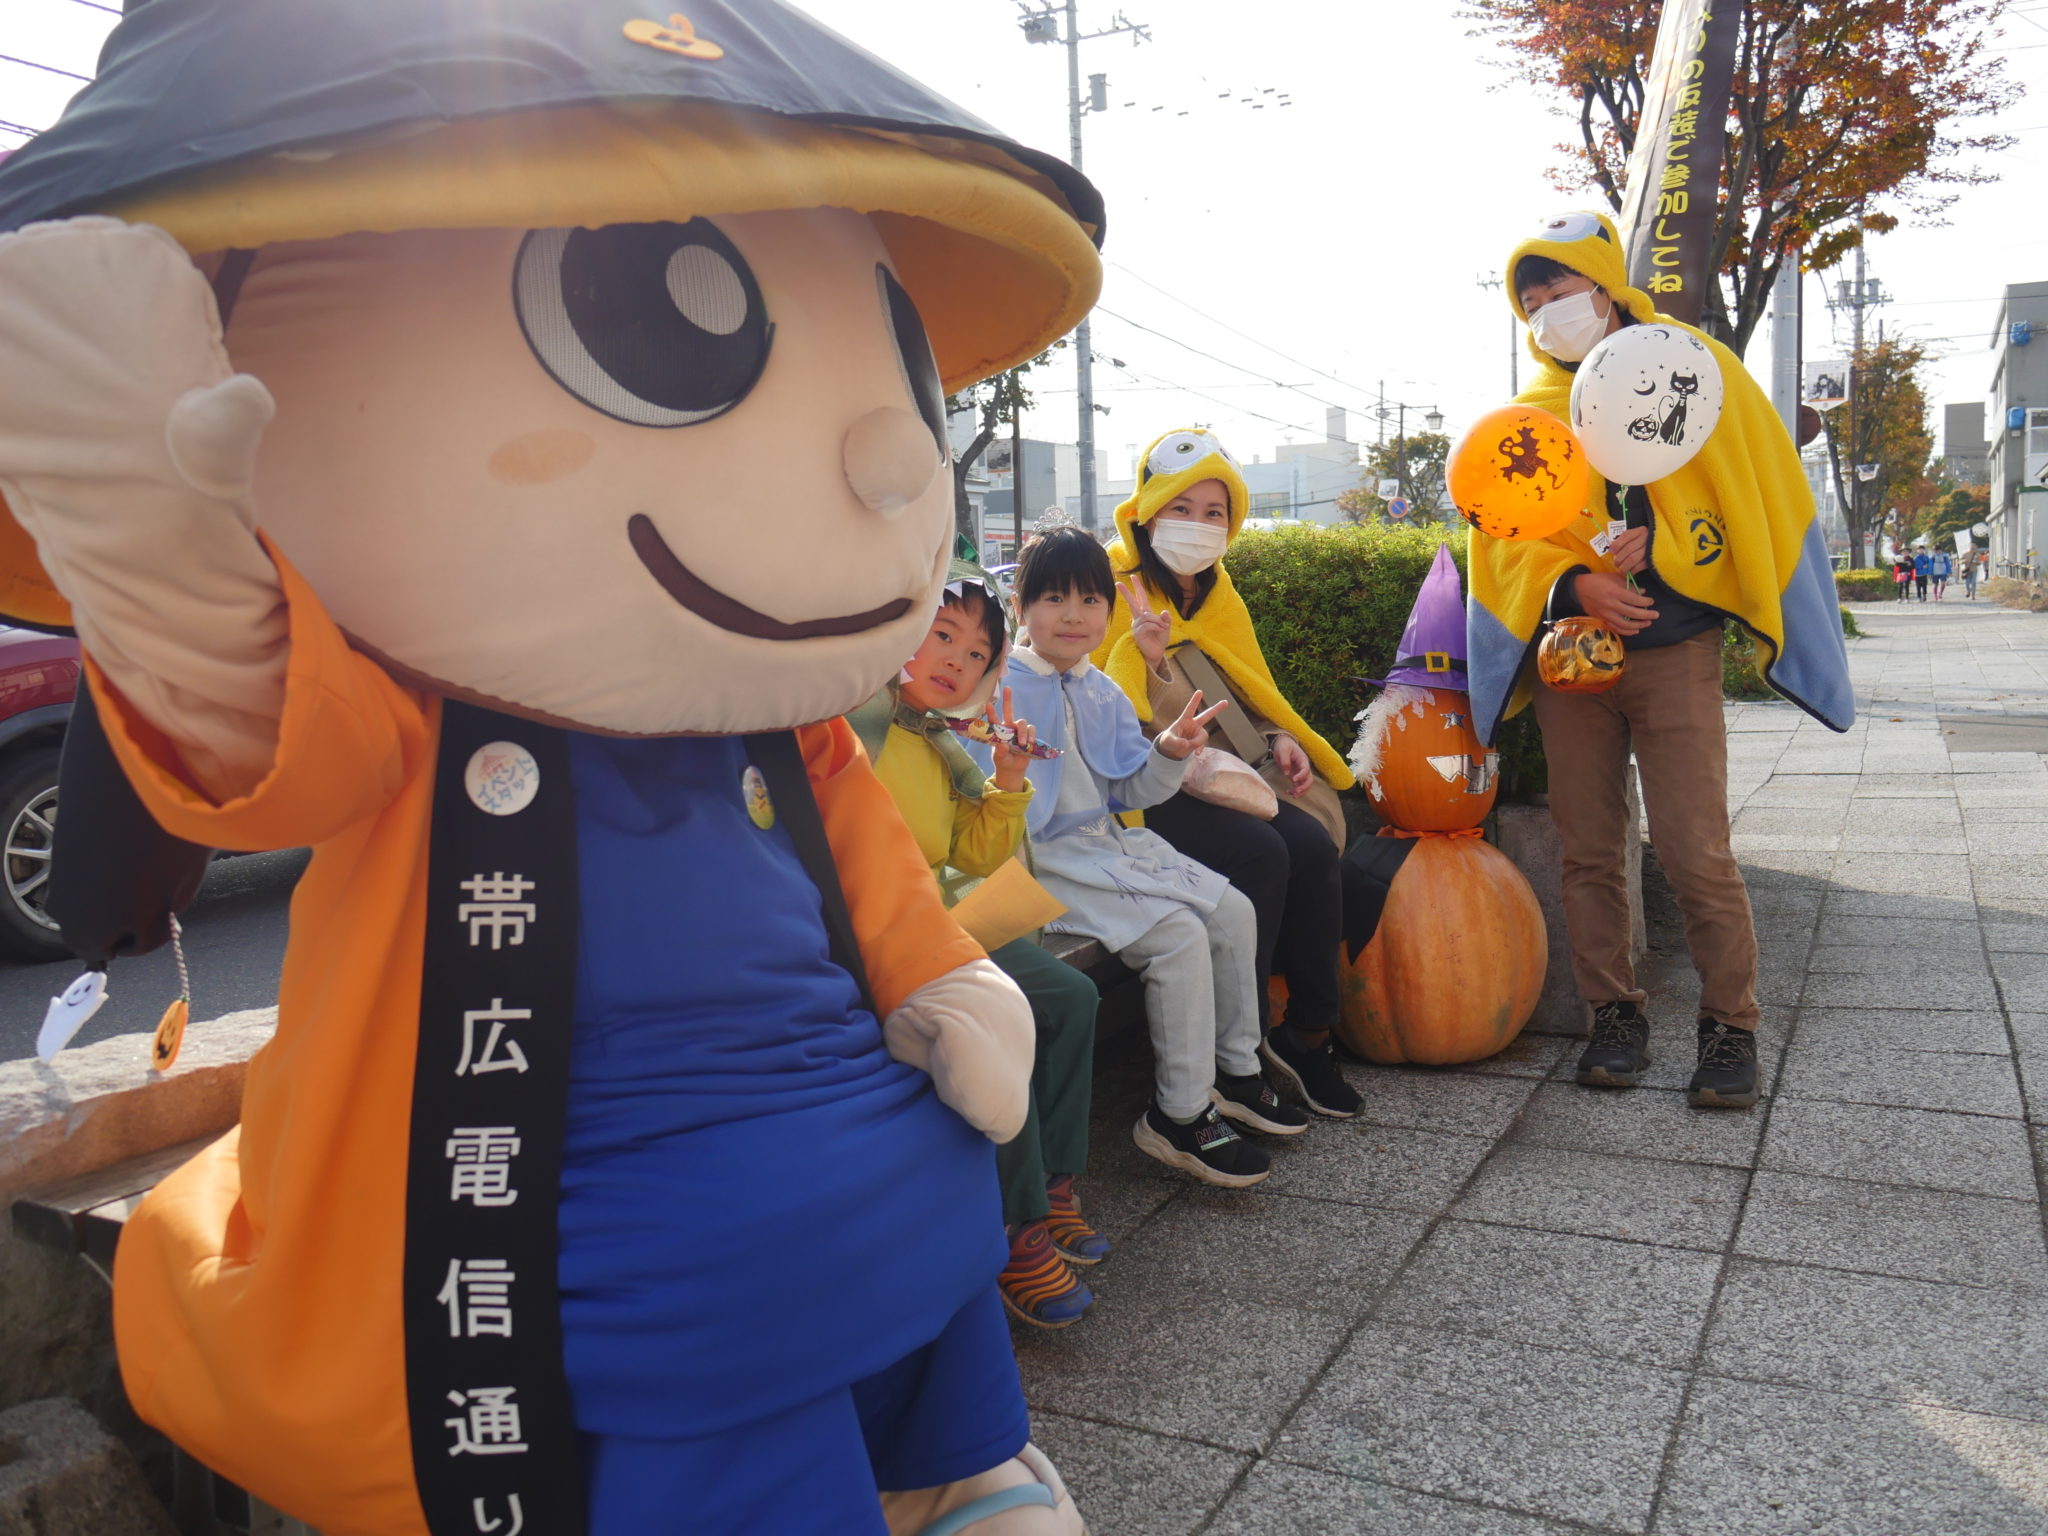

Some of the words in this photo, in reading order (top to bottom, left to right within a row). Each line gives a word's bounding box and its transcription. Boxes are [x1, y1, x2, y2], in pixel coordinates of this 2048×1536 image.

[436, 871, 537, 1536] 帯広電信通り
